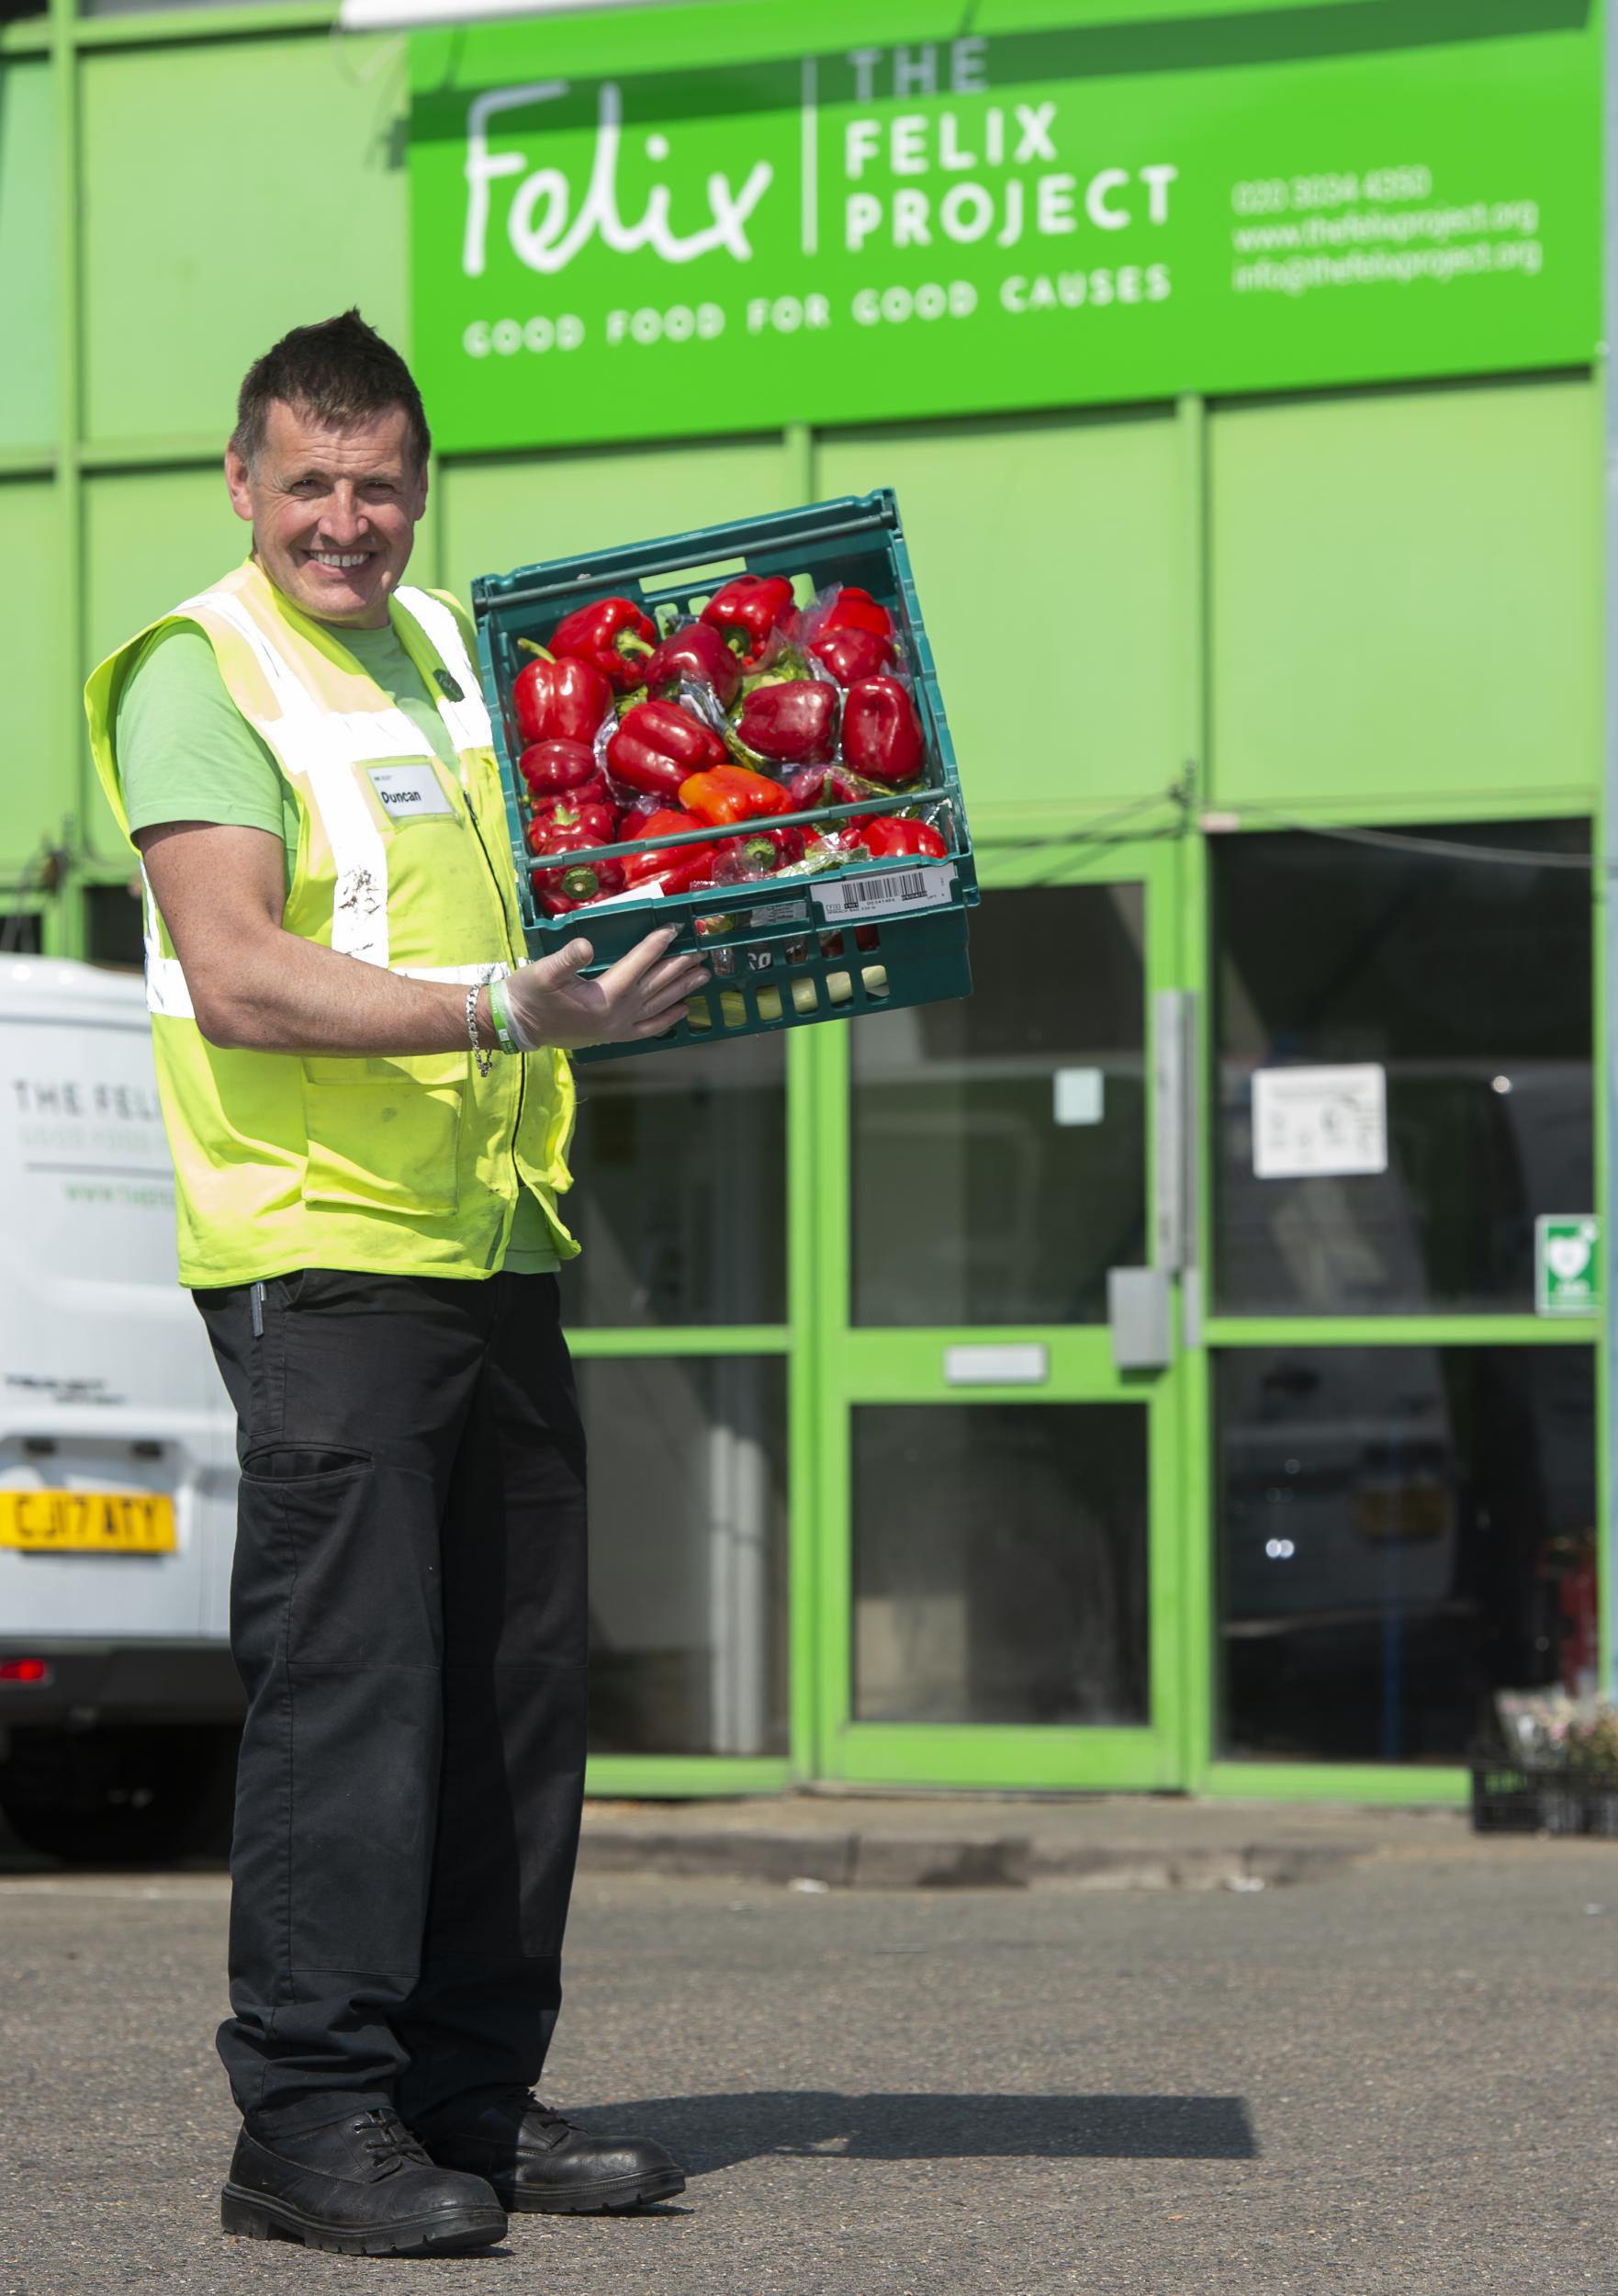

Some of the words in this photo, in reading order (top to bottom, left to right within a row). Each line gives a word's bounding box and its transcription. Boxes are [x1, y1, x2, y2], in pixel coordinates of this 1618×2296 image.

[848, 37, 989, 103] THE
[846, 101, 1057, 180] FELIX
[463, 80, 773, 277] Felix
[846, 164, 1177, 252] PROJECT
[1232, 200, 1539, 253] www.thefelixproject.org
[1231, 241, 1542, 296] info@thefelixproject.org
[463, 314, 584, 357] GOOD
[606, 303, 725, 345] FOOD
[747, 294, 829, 334] FOR
[852, 281, 978, 325] GOOD
[1000, 264, 1172, 313] CAUSES
[380, 791, 421, 805] Duncan
[15, 1079, 83, 1117] THE
